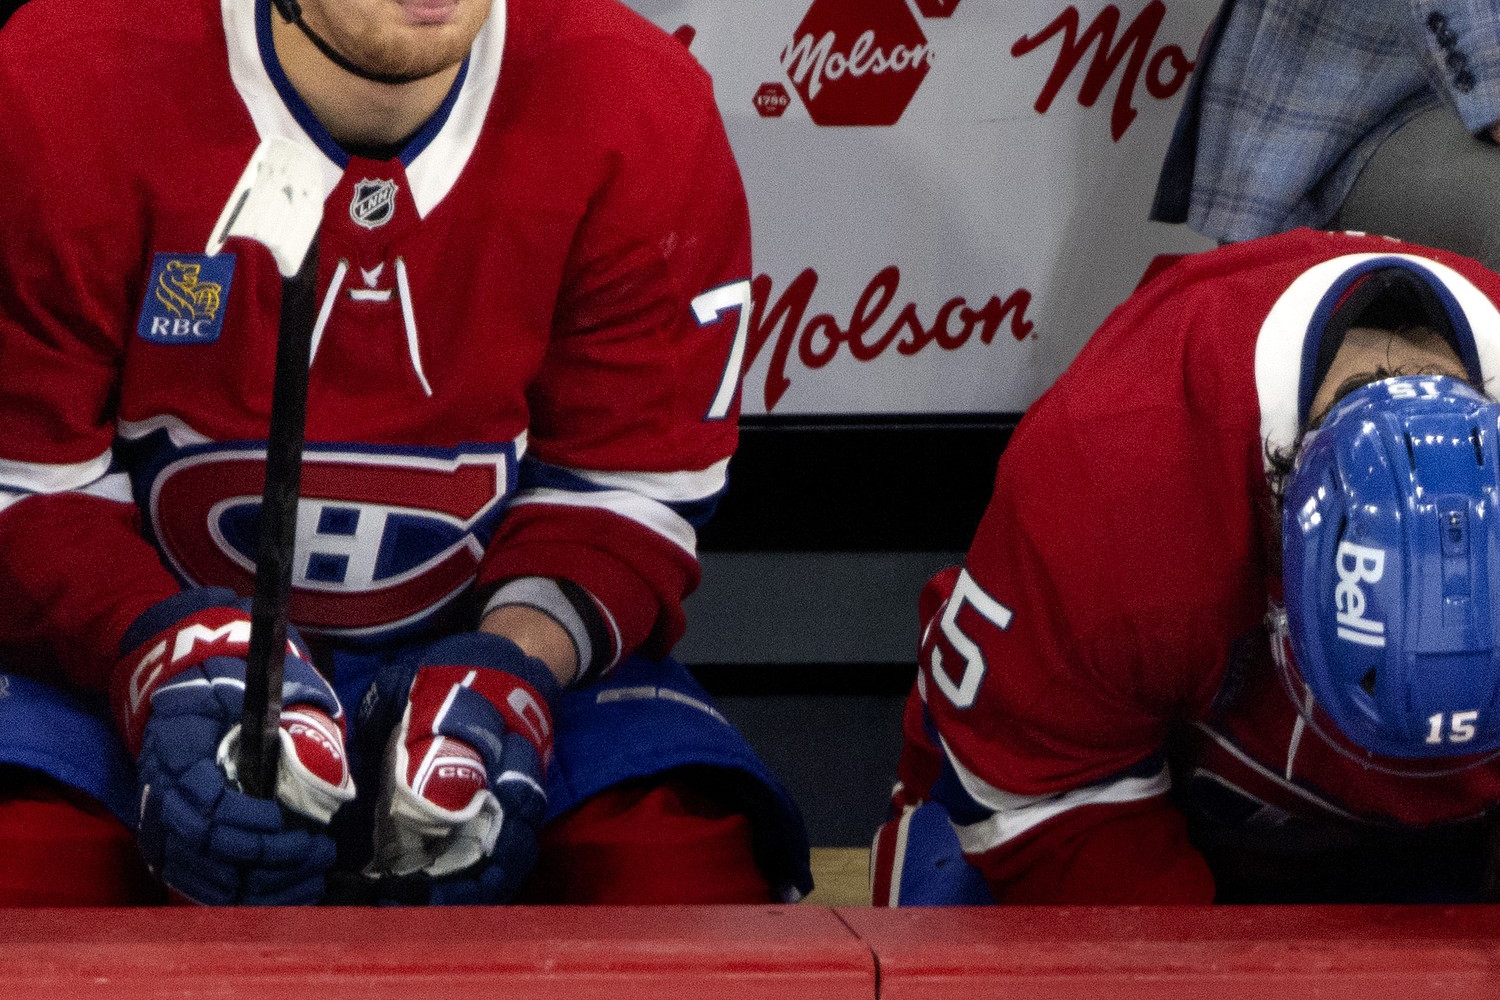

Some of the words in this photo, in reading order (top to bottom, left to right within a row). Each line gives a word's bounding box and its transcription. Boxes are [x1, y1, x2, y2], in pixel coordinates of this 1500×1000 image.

[779, 29, 937, 101] Molson
[359, 188, 389, 217] LNH
[150, 316, 212, 338] RBC
[689, 278, 751, 422] 7
[1334, 541, 1387, 648] Bell
[918, 567, 1015, 710] 5
[1424, 709, 1479, 745] 15
